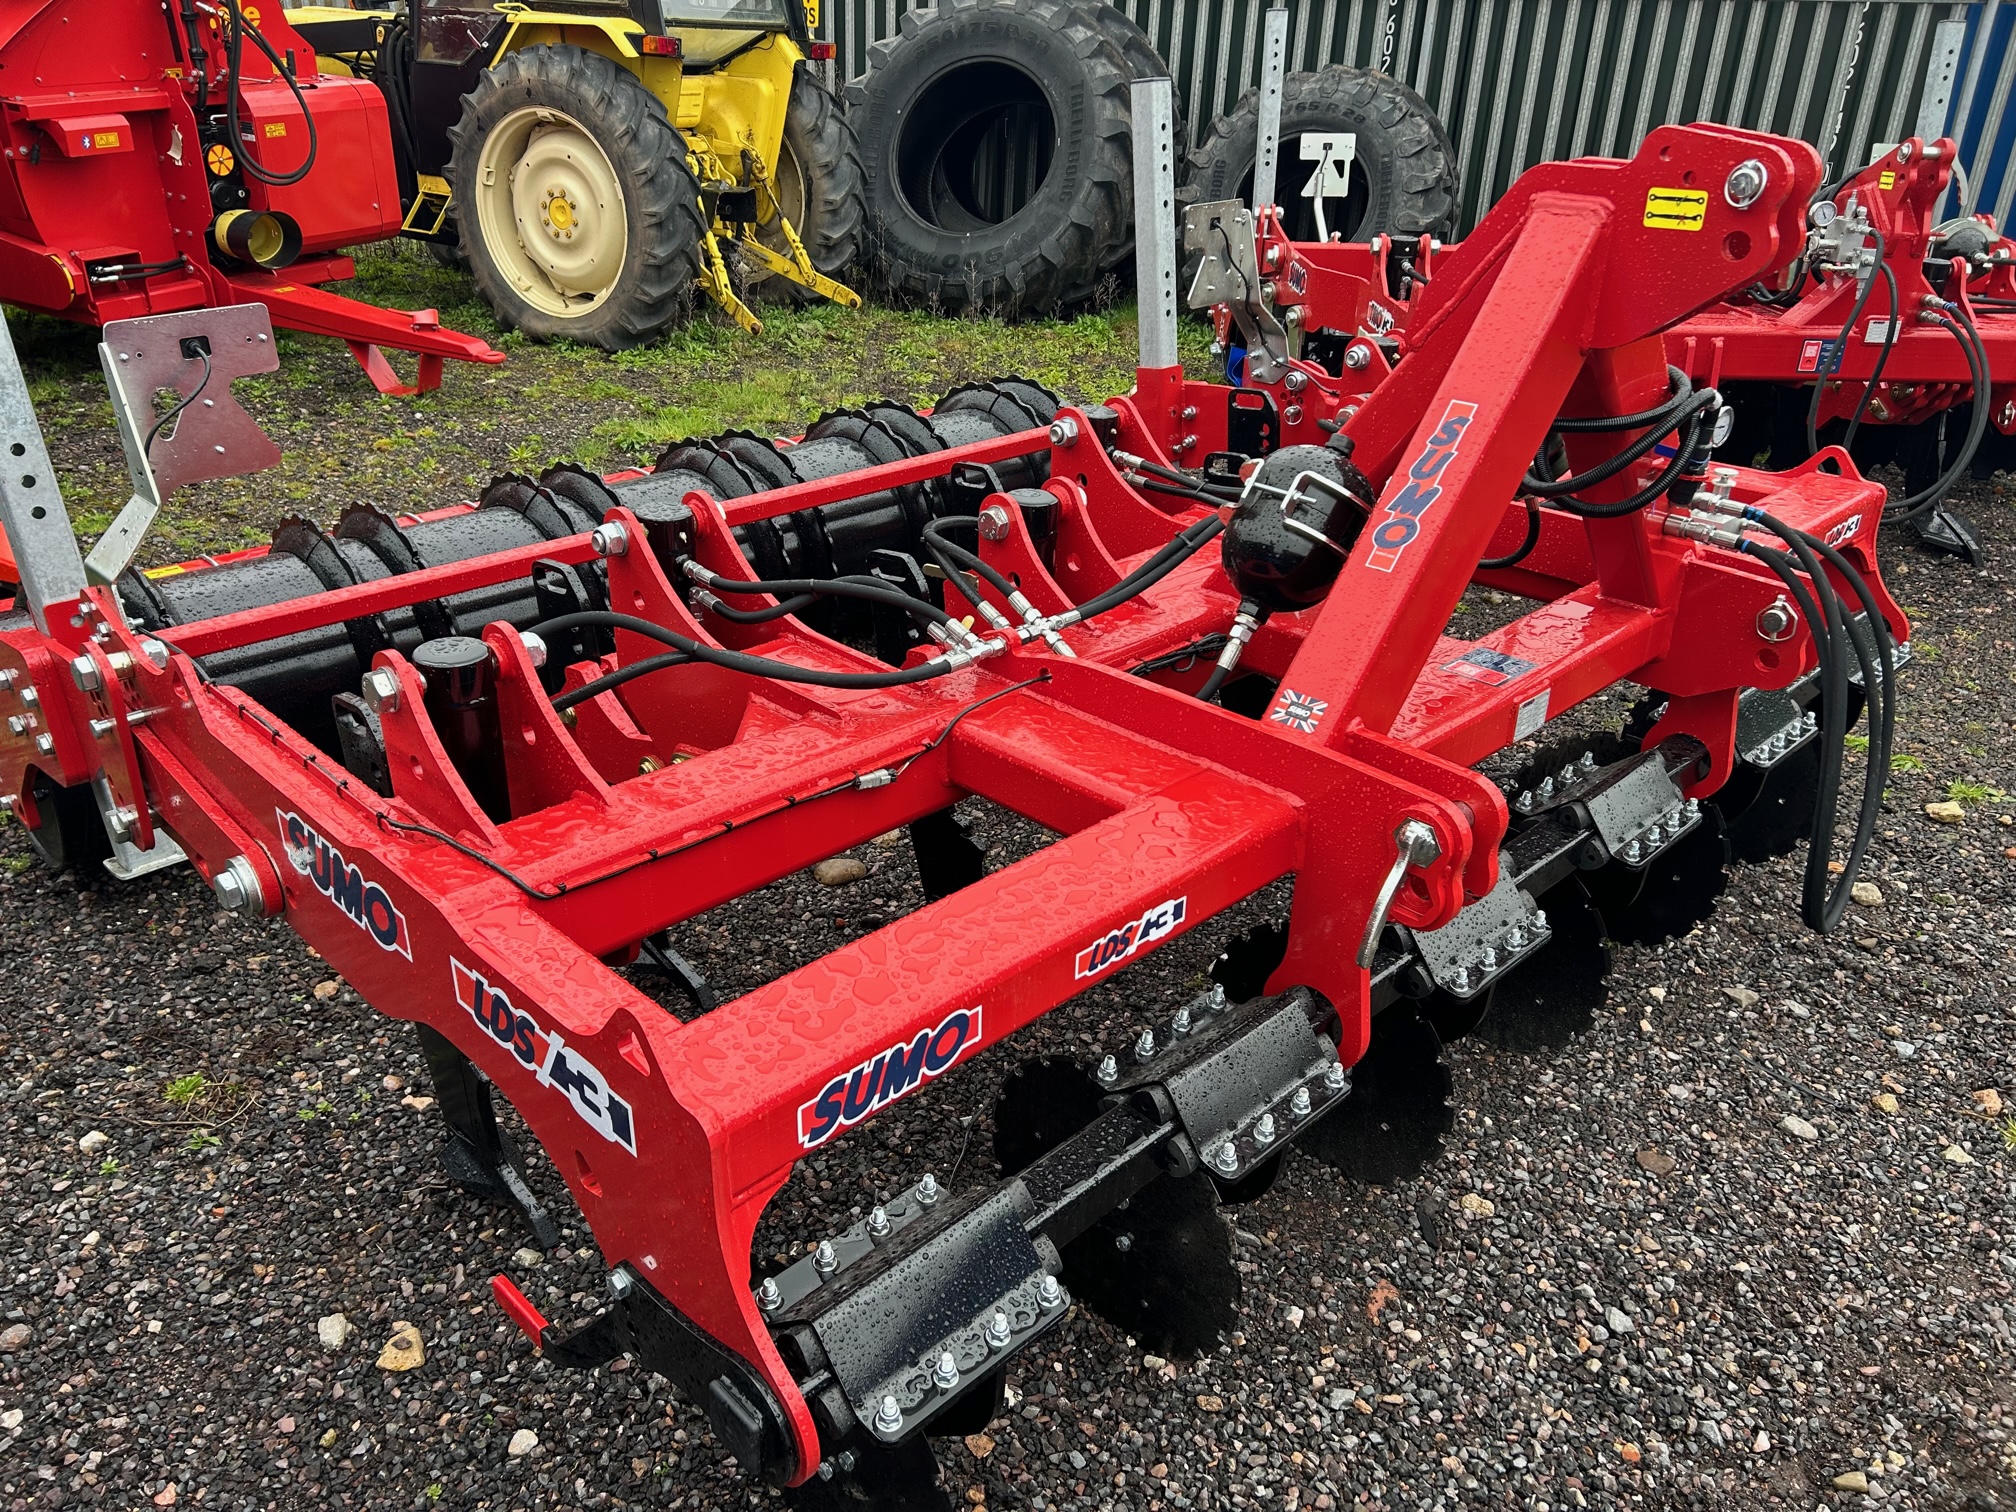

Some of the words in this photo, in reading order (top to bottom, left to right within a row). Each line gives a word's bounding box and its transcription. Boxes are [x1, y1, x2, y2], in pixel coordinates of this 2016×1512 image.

[1059, 78, 1085, 203] TRELLEBORG
[1341, 108, 1367, 124] 28
[1374, 415, 1473, 549] SUMO
[286, 815, 399, 948] SUMO
[807, 1012, 971, 1144] SUMO
